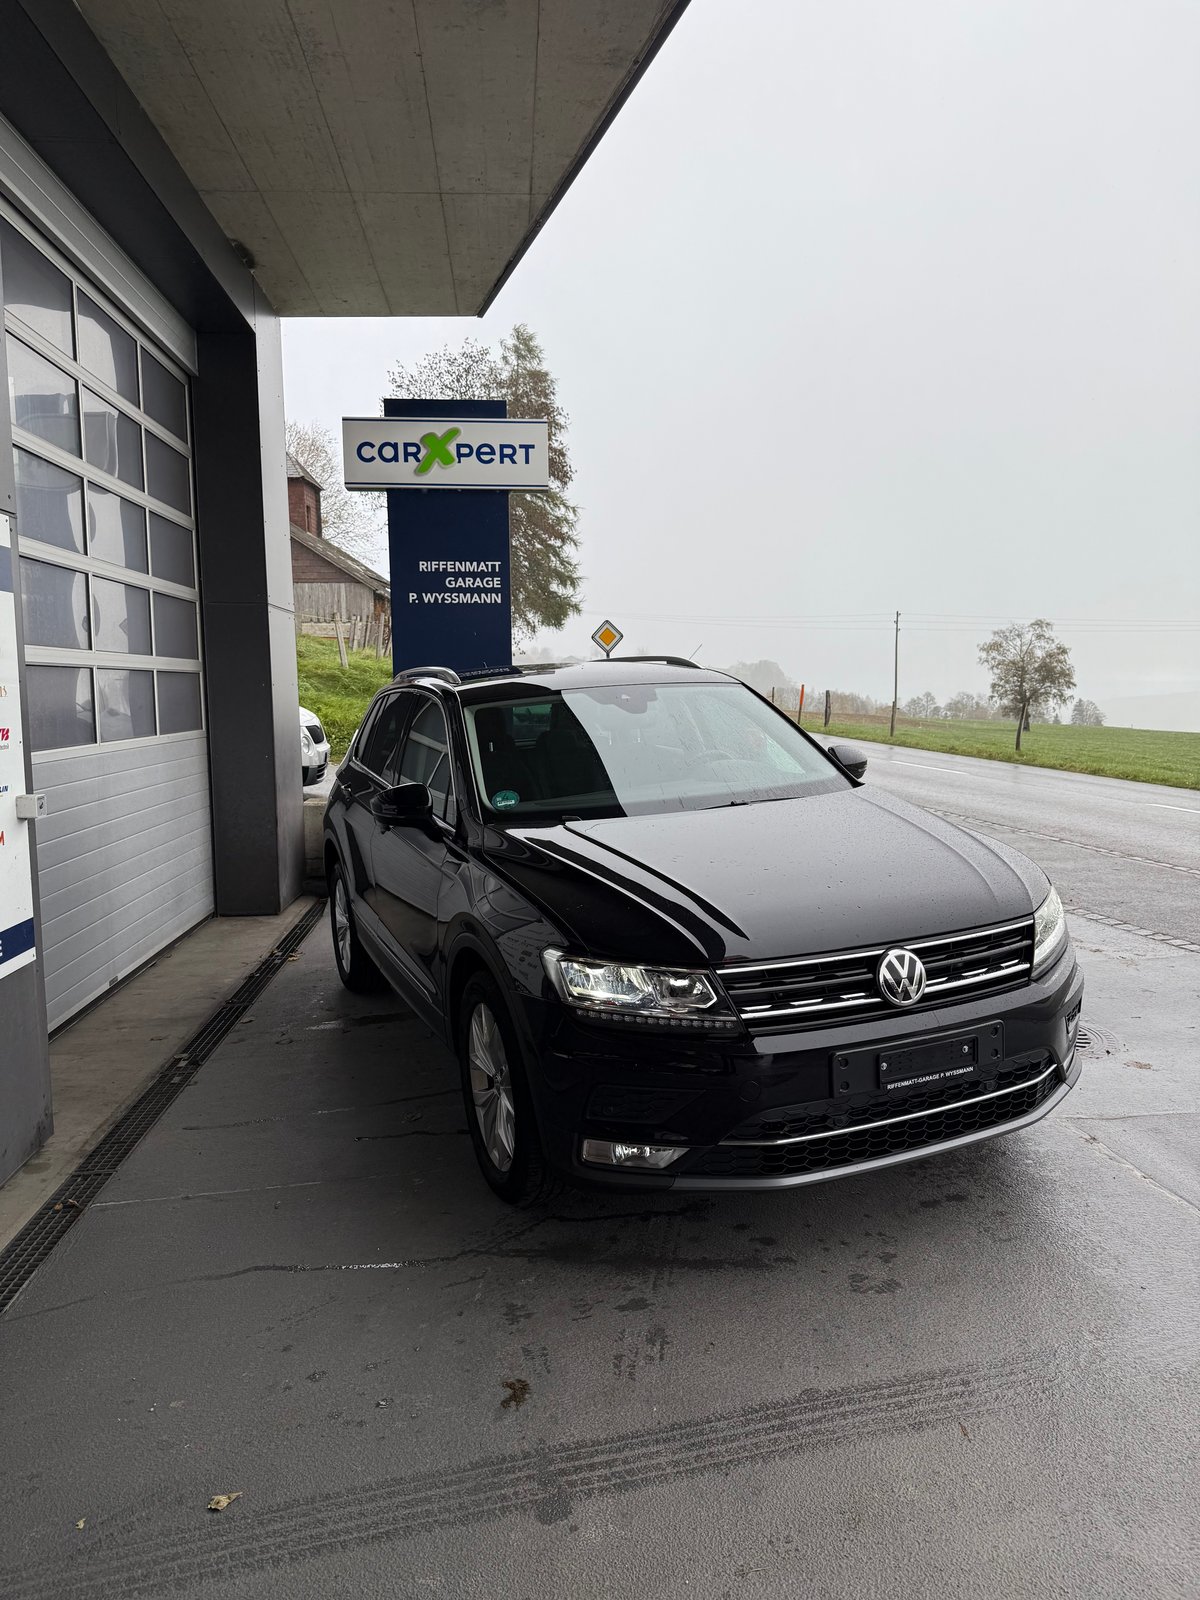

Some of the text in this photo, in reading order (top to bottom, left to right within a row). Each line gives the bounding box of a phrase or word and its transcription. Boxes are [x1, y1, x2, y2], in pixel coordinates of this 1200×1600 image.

[418, 561, 502, 573] RIFFENMATT
[445, 577, 502, 588] GARAGE
[408, 592, 502, 604] P. WYSSMANN
[887, 1073, 940, 1090] RIFFENMATT-GARAGE
[945, 1066, 974, 1077] WYSSMANN
